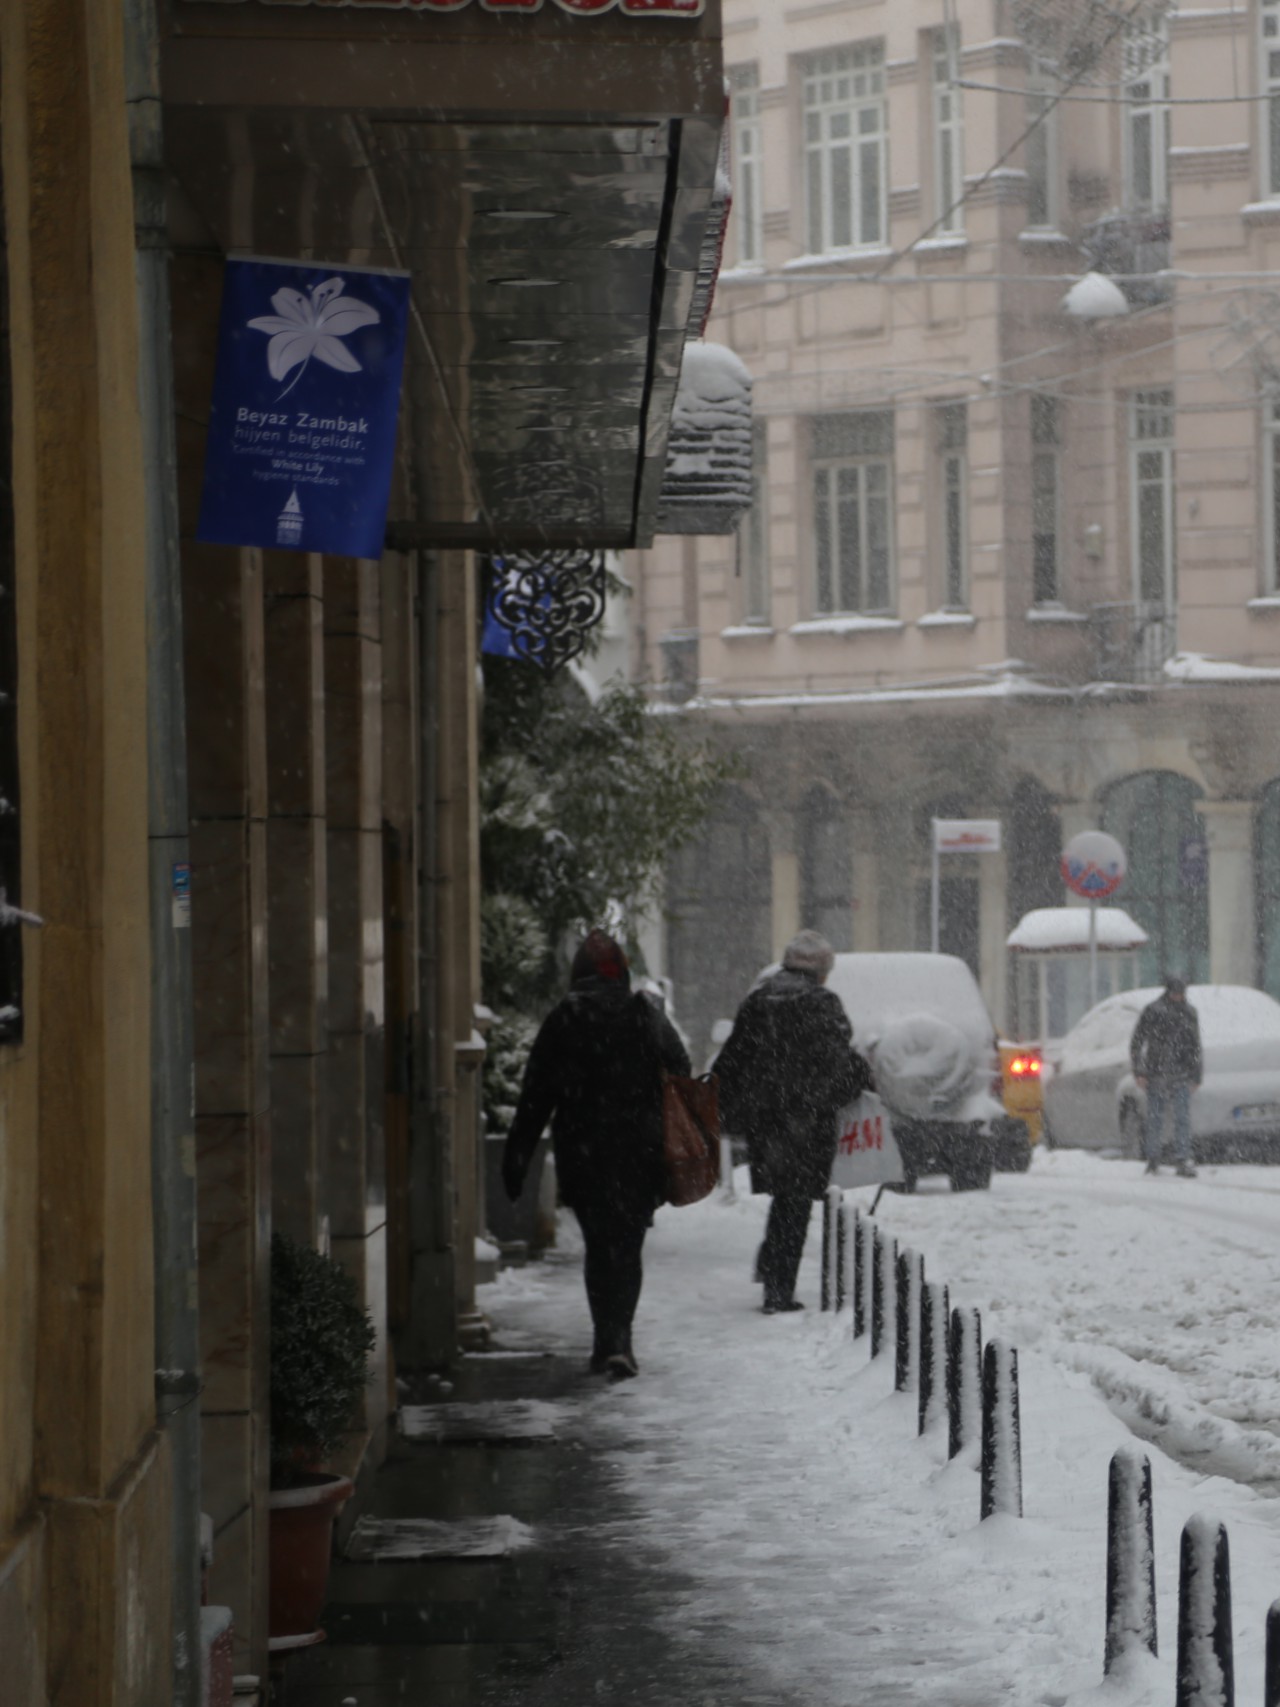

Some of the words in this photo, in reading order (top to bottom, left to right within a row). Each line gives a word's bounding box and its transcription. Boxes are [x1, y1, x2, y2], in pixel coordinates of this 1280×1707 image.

[236, 407, 288, 427] Beyaz
[296, 413, 369, 433] Zambak
[234, 425, 281, 443] hijyen
[288, 429, 366, 450] belgelidir.
[271, 459, 303, 471] White
[305, 462, 325, 476] Lily
